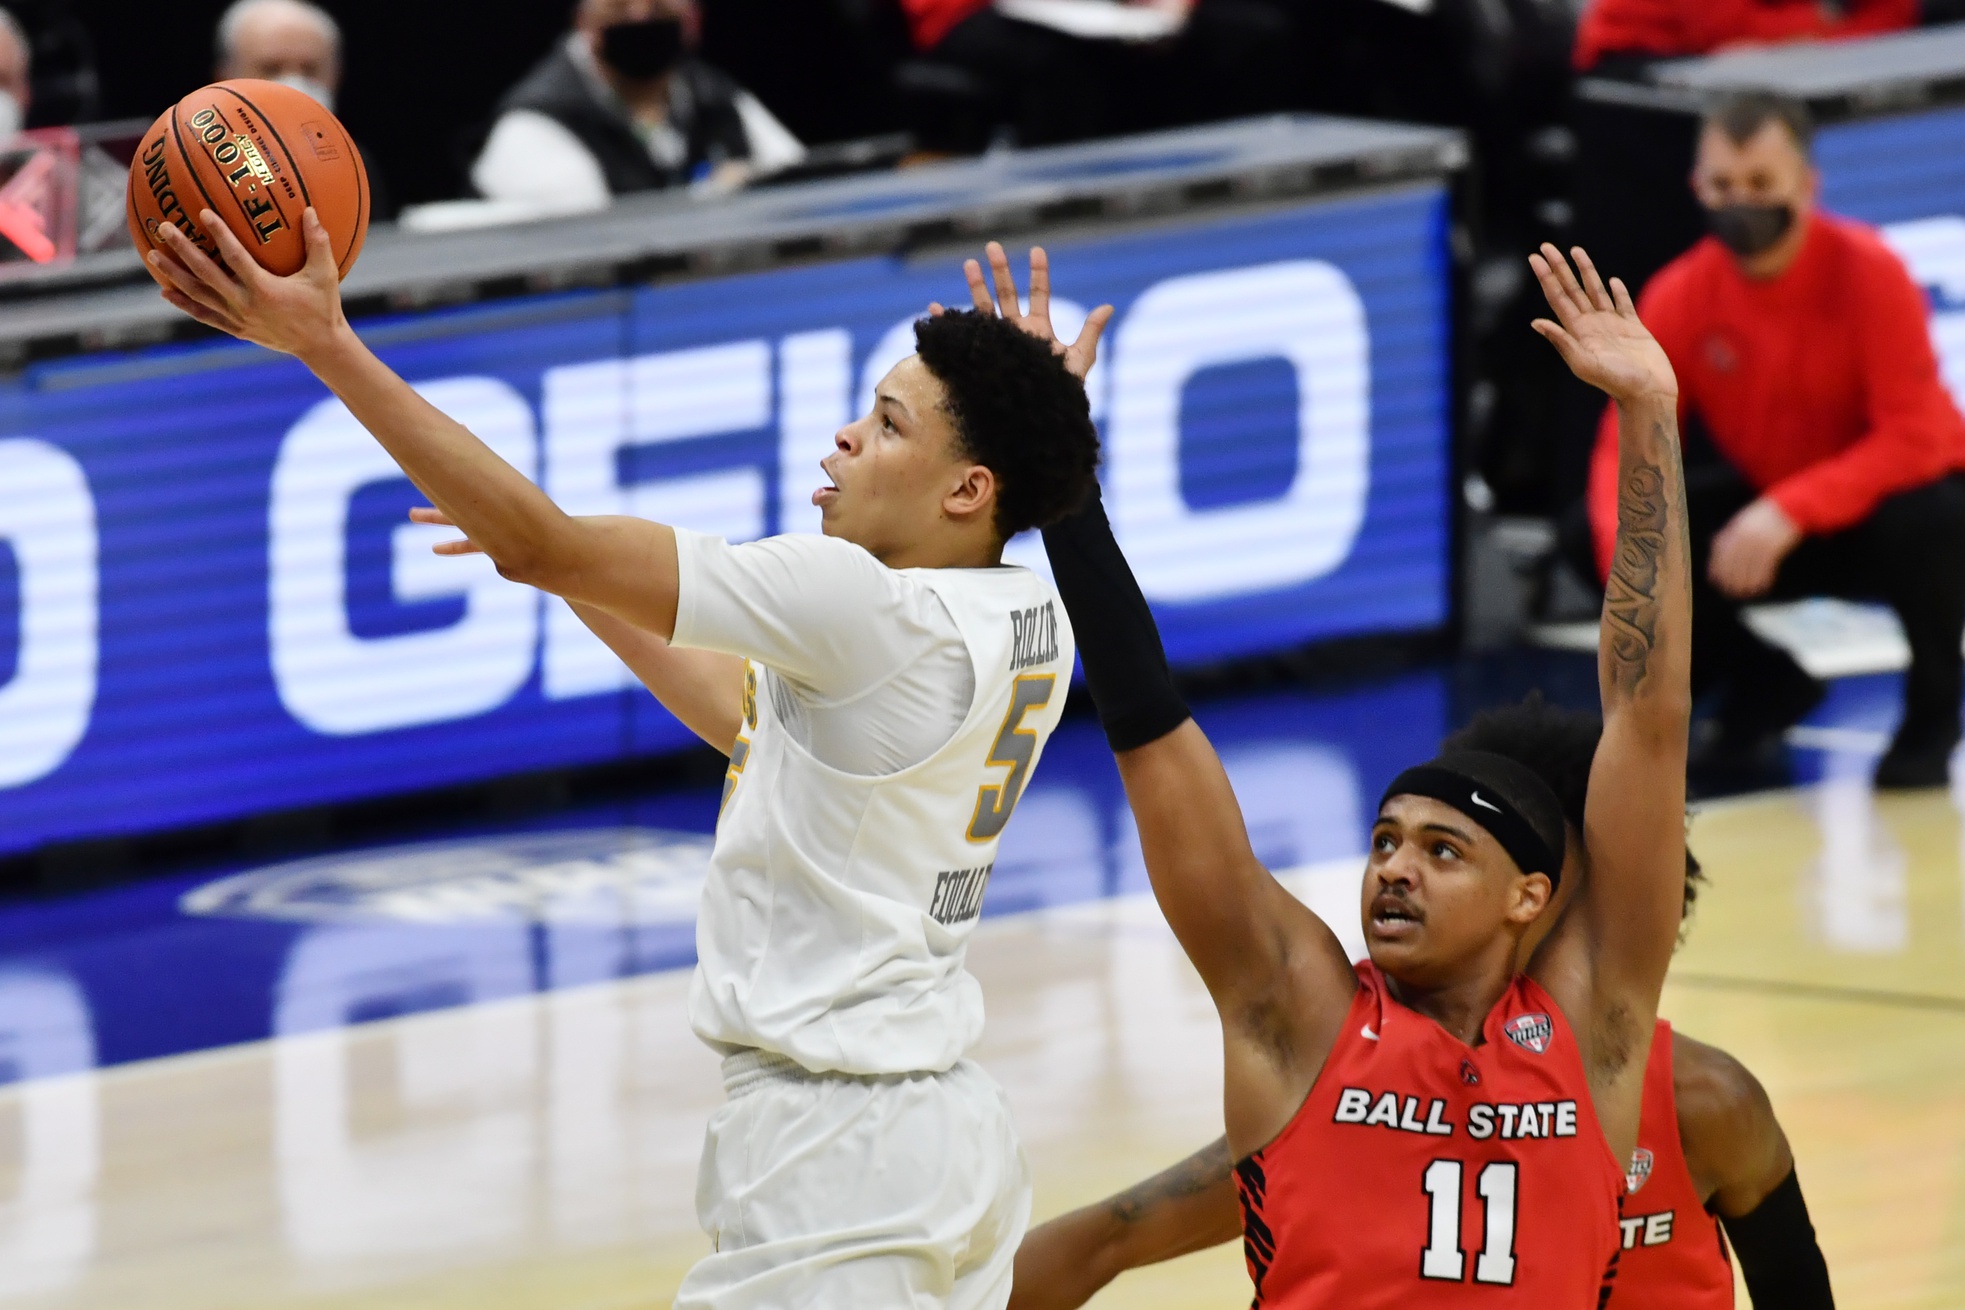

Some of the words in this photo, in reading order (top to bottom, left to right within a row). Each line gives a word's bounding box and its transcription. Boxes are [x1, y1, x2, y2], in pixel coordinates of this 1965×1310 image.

[191, 108, 284, 245] TF-1000
[236, 107, 257, 134] DESIGN
[143, 136, 236, 277] PALDING
[280, 176, 295, 198] DEEP
[966, 674, 1056, 843] 5
[1333, 1087, 1455, 1136] BALL
[1466, 1101, 1577, 1139] STATE
[1420, 1159, 1519, 1286] 11
